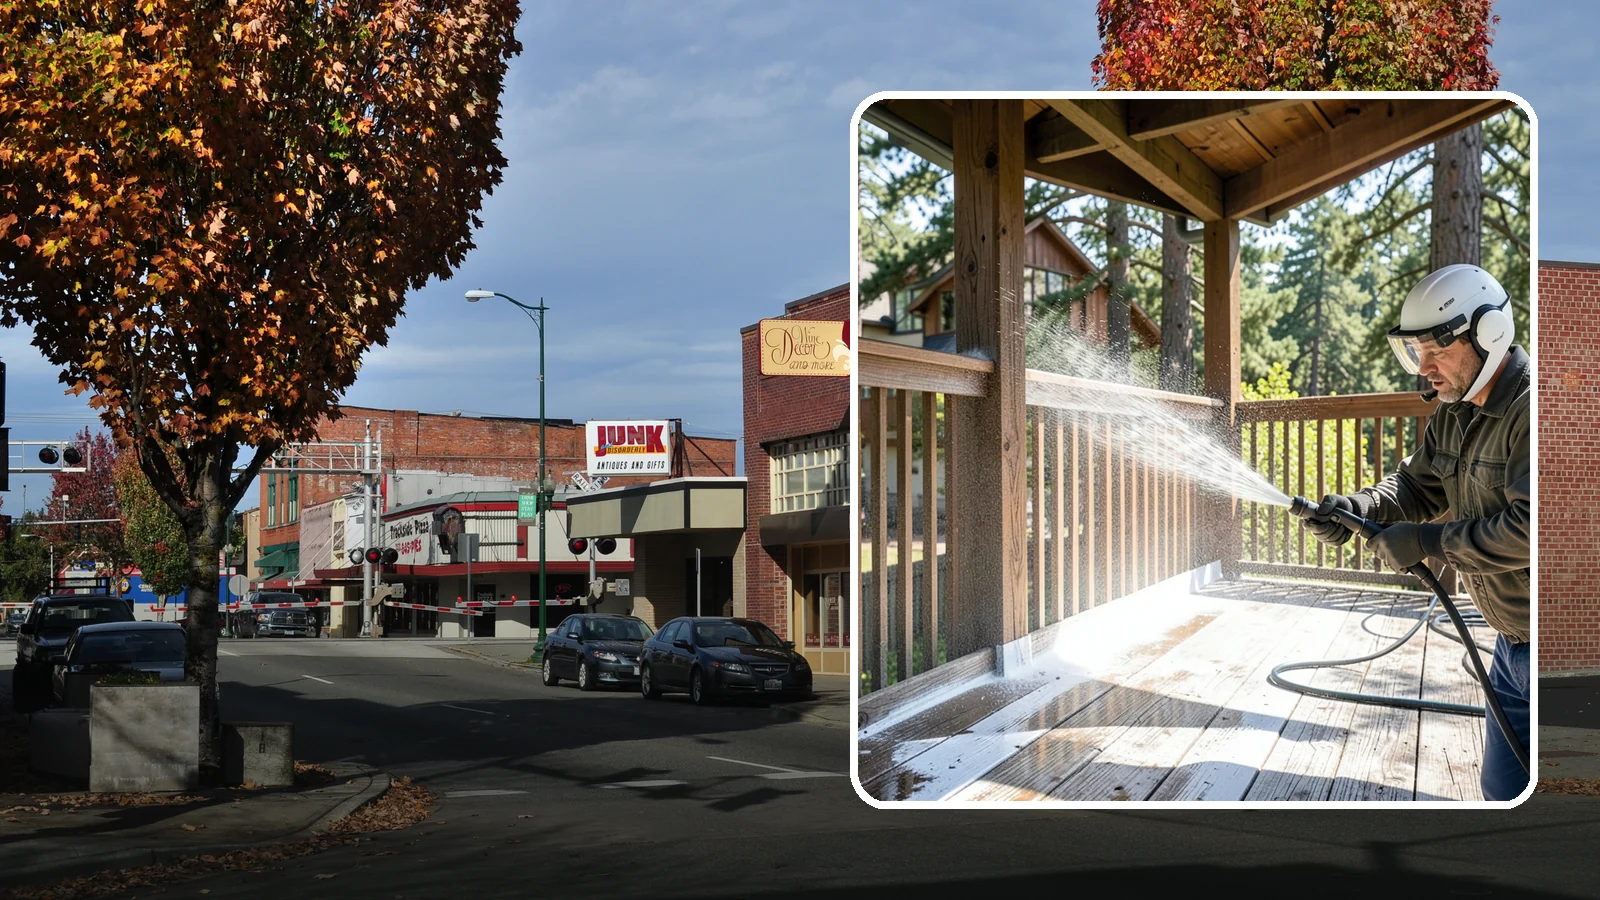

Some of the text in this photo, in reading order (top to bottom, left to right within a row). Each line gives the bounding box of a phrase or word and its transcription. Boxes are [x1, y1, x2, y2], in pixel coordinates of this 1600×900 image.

[595, 425, 665, 457] JUNK
[607, 446, 646, 454] DISORDERLY
[597, 461, 665, 470] ANTIQUES AND GIFTS
[414, 519, 429, 535] Pizza
